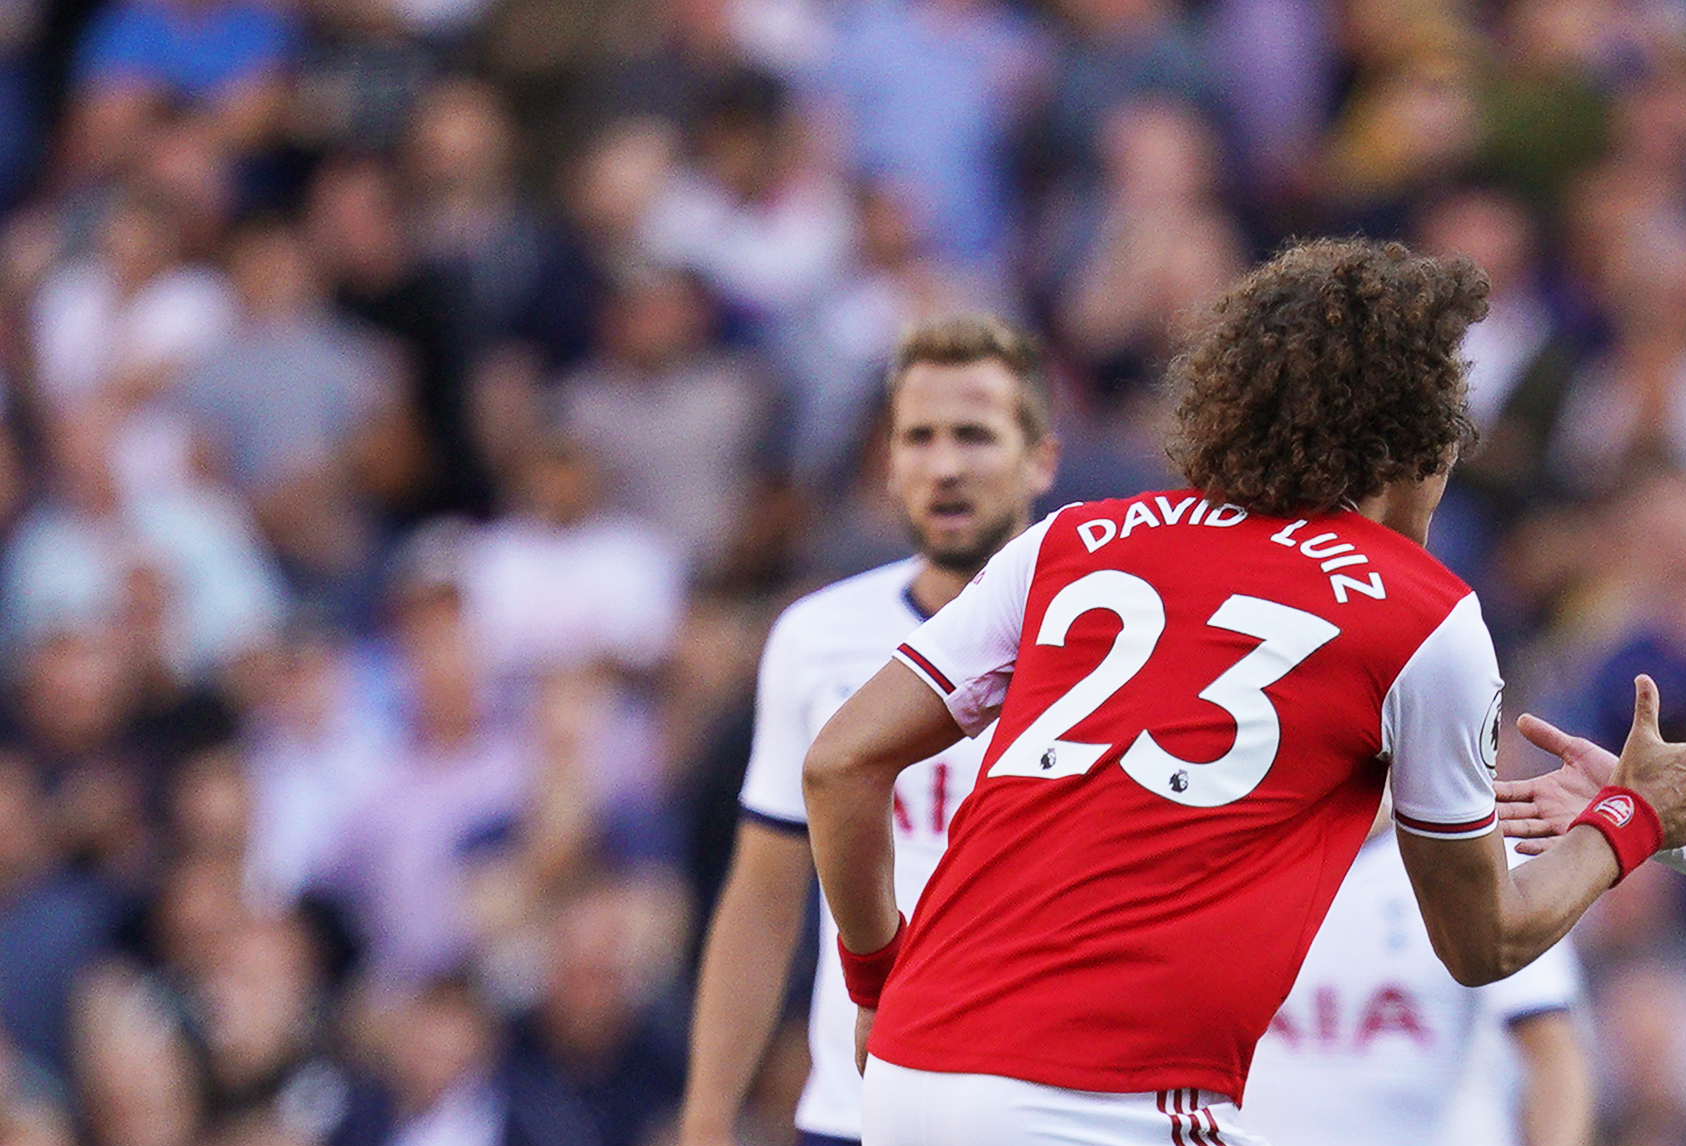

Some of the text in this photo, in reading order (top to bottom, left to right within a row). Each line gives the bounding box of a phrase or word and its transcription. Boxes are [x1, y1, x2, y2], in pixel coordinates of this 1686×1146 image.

[1076, 496, 1387, 603] DAVID LUIZ
[986, 568, 1341, 807] 23
